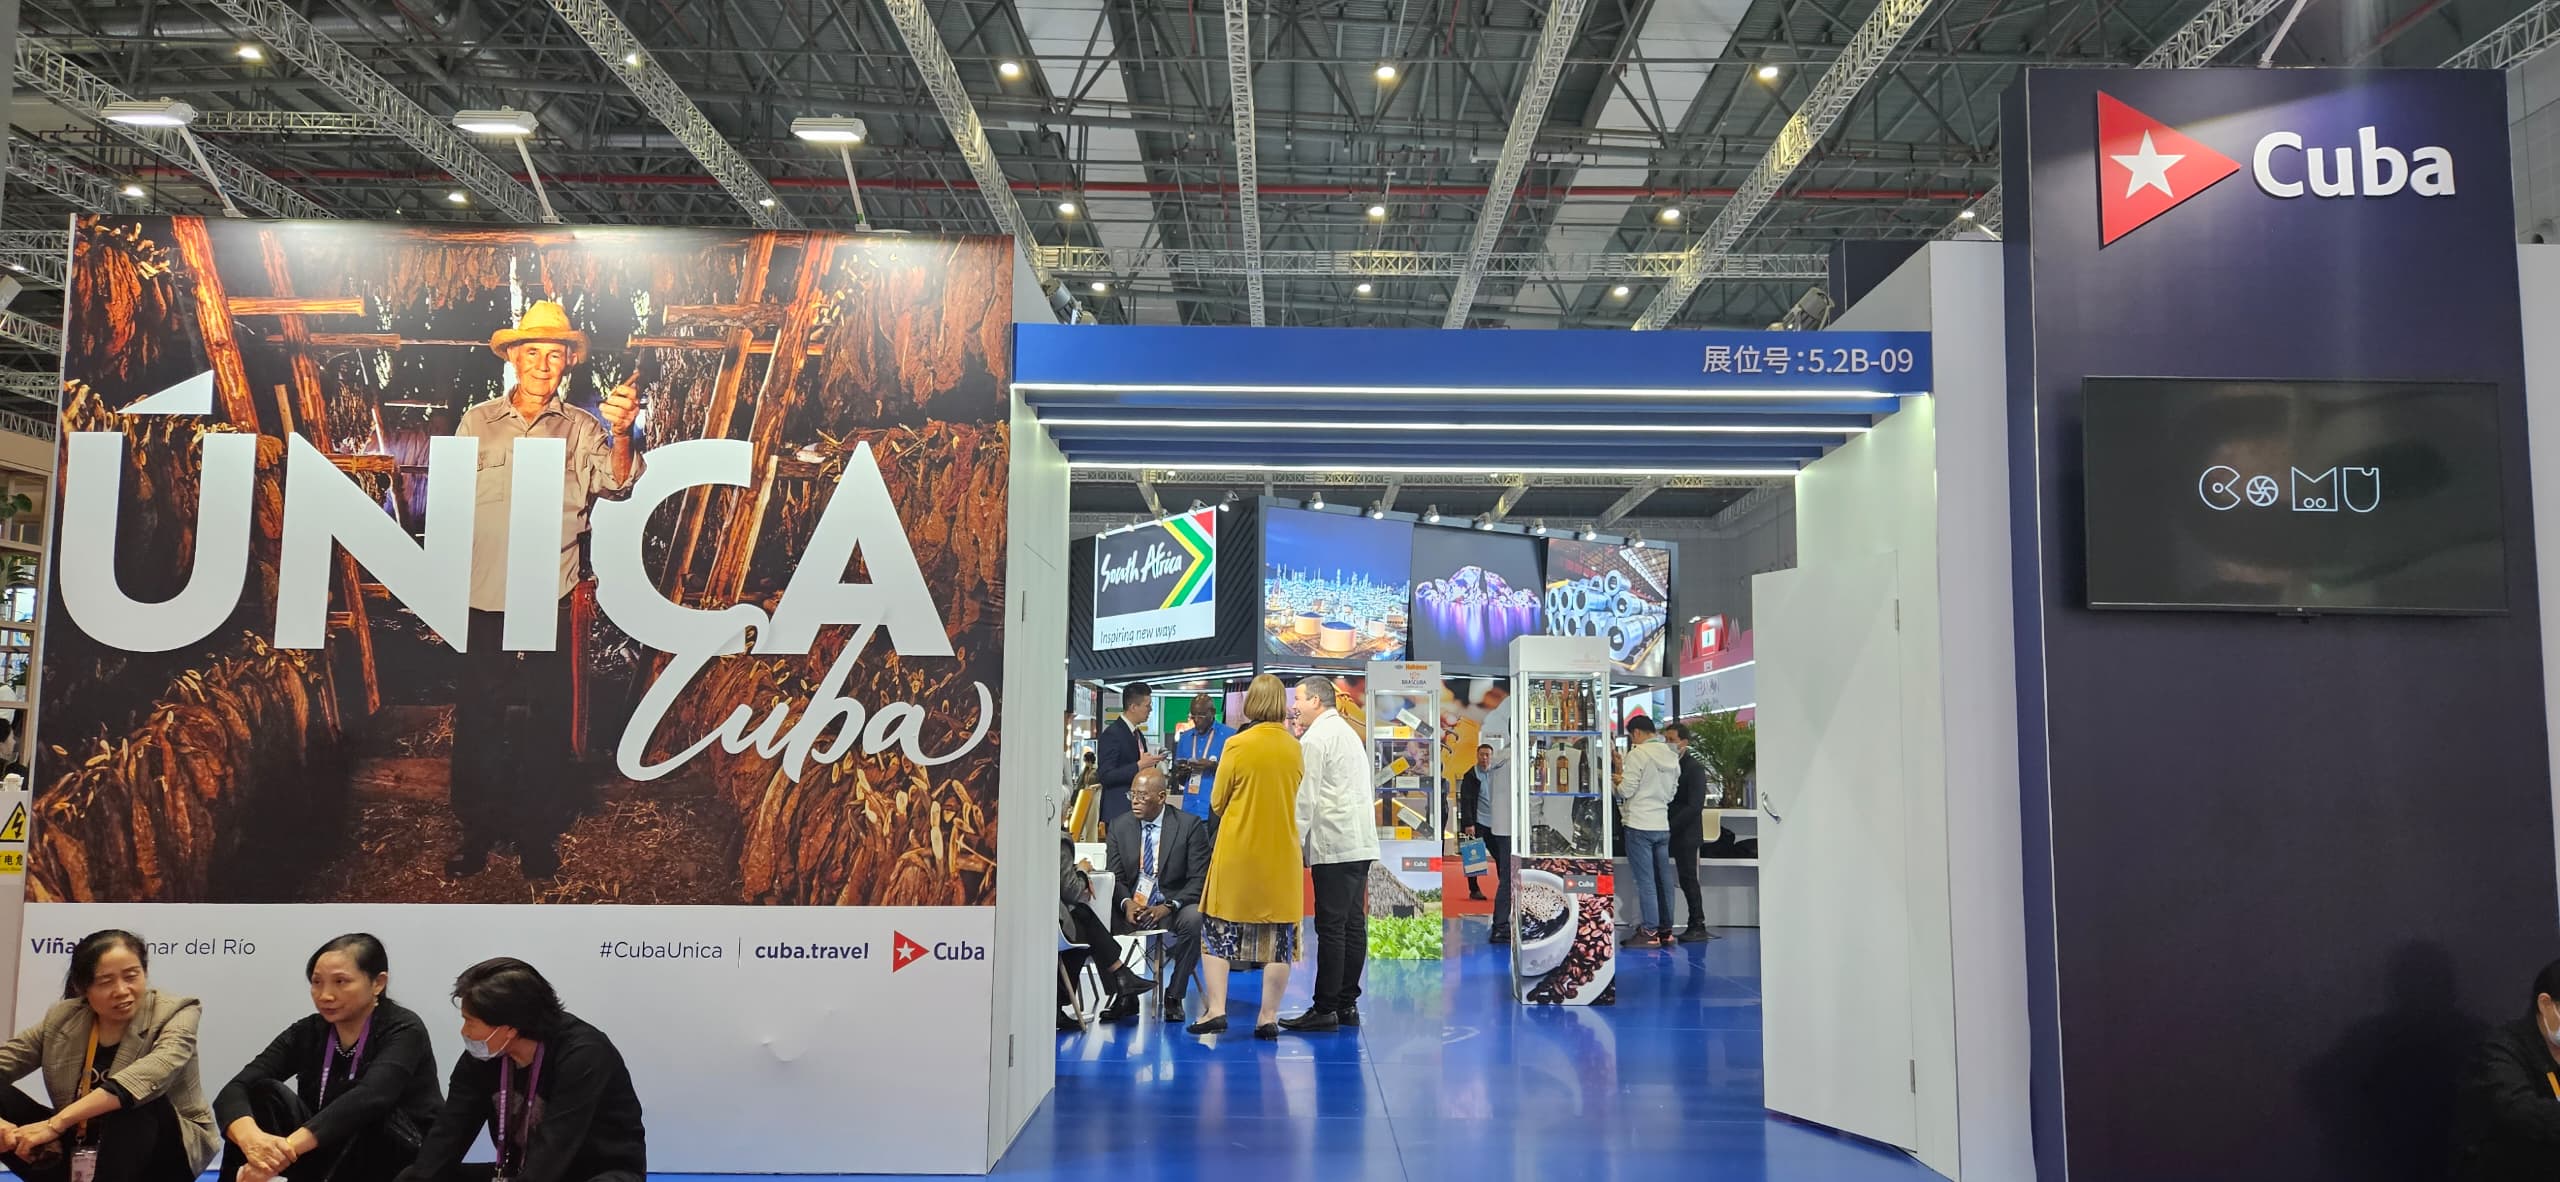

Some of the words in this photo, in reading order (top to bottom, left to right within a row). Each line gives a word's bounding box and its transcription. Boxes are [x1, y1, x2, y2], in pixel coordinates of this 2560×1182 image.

[2252, 126, 2456, 198] Cuba
[1702, 345, 1914, 375] 展位号:5.2B-09
[59, 370, 955, 656] ÚNICA
[1100, 550, 1140, 593] South
[1140, 542, 1182, 582] Africa
[1100, 627, 1134, 646] Inspiring
[1136, 628, 1154, 640] new
[1155, 624, 1177, 639] ways
[616, 604, 996, 782] Cuba
[0, 854, 23, 866] 电危
[1577, 880, 1595, 888] Cuba
[31, 938, 85, 954] Viña
[145, 942, 178, 955] nar
[185, 938, 216, 955] del
[223, 938, 256, 955] Río
[600, 941, 723, 959] #CubaUnica
[754, 941, 870, 960] cuba.travel
[933, 941, 985, 961] Cuba
